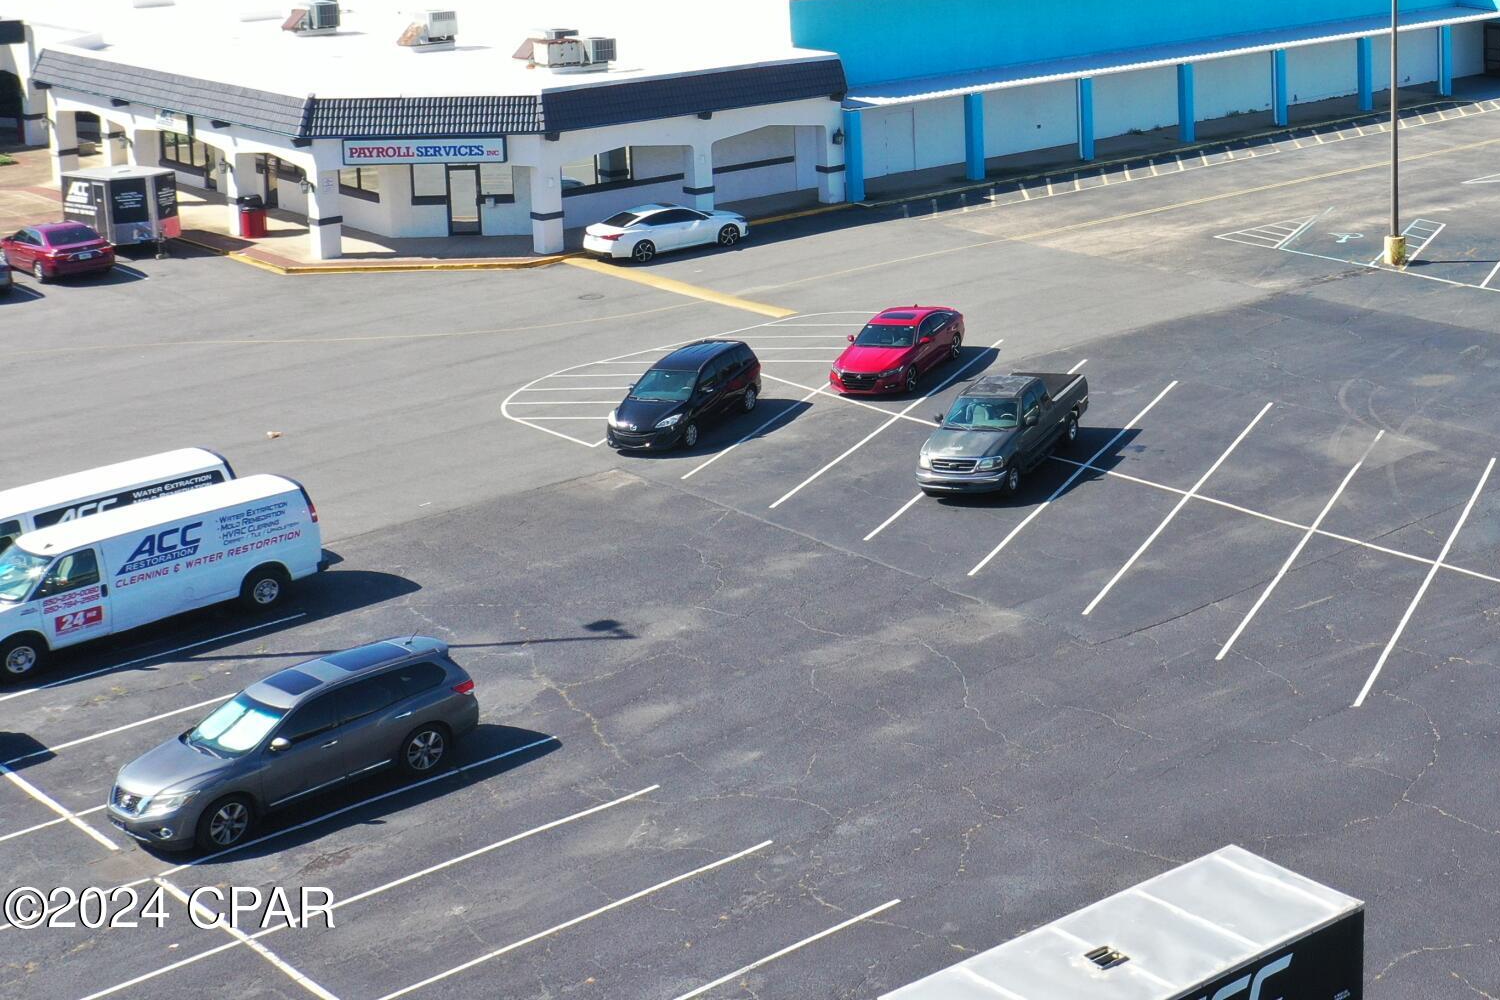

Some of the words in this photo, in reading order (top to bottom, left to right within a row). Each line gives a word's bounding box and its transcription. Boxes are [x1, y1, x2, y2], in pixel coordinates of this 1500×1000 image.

[349, 146, 415, 159] PAYROLL
[416, 145, 485, 158] SERVICES
[132, 484, 163, 499] WATER
[163, 474, 213, 491] EXTRACTION
[219, 512, 245, 524] WATER
[246, 501, 288, 517] EXTRACTION
[220, 521, 241, 532] MOLD
[222, 527, 247, 540] HVAC
[126, 521, 204, 563] ACC
[115, 566, 169, 588] CLEANING
[173, 560, 182, 573] &
[185, 552, 223, 569] WATER
[227, 529, 302, 558] RESTORATION
[124, 548, 195, 572] RESTORATION
[60, 611, 85, 630] 24
